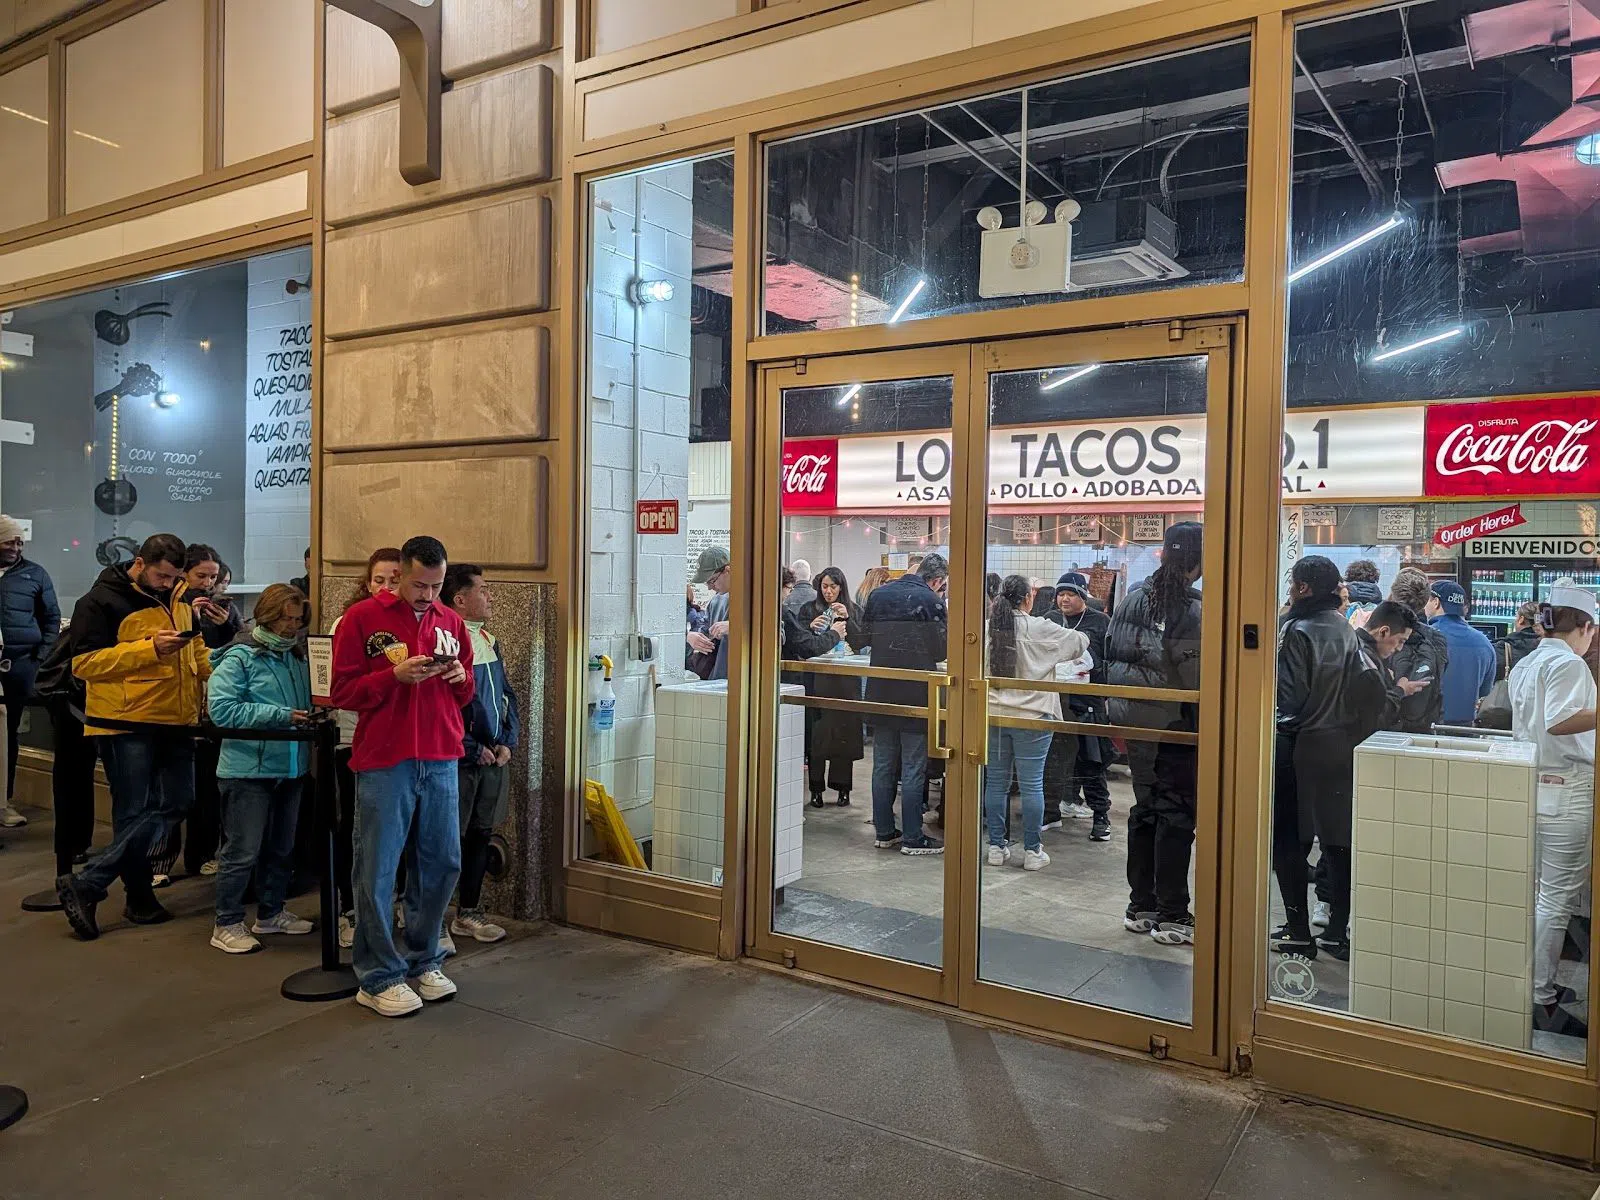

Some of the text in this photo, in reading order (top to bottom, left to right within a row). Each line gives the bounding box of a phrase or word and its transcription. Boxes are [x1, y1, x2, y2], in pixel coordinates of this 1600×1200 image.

[280, 325, 312, 346] TACO
[1478, 418, 1519, 427] DISFRUTA
[248, 422, 289, 443] AGUAS
[896, 438, 951, 482] LO
[1011, 425, 1182, 478] TACOS
[1435, 419, 1598, 475] Coca-Cola
[166, 467, 222, 479] GUACAMOLE
[168, 485, 213, 496] CILANTRO
[170, 492, 202, 502] SALSA
[906, 486, 951, 501] ASA
[1000, 482, 1067, 498] POLLO
[1082, 478, 1202, 497] ADOBADA
[640, 512, 675, 529] OPEN
[1441, 508, 1516, 543] Order Here!
[1293, 953, 1313, 967] PETS
